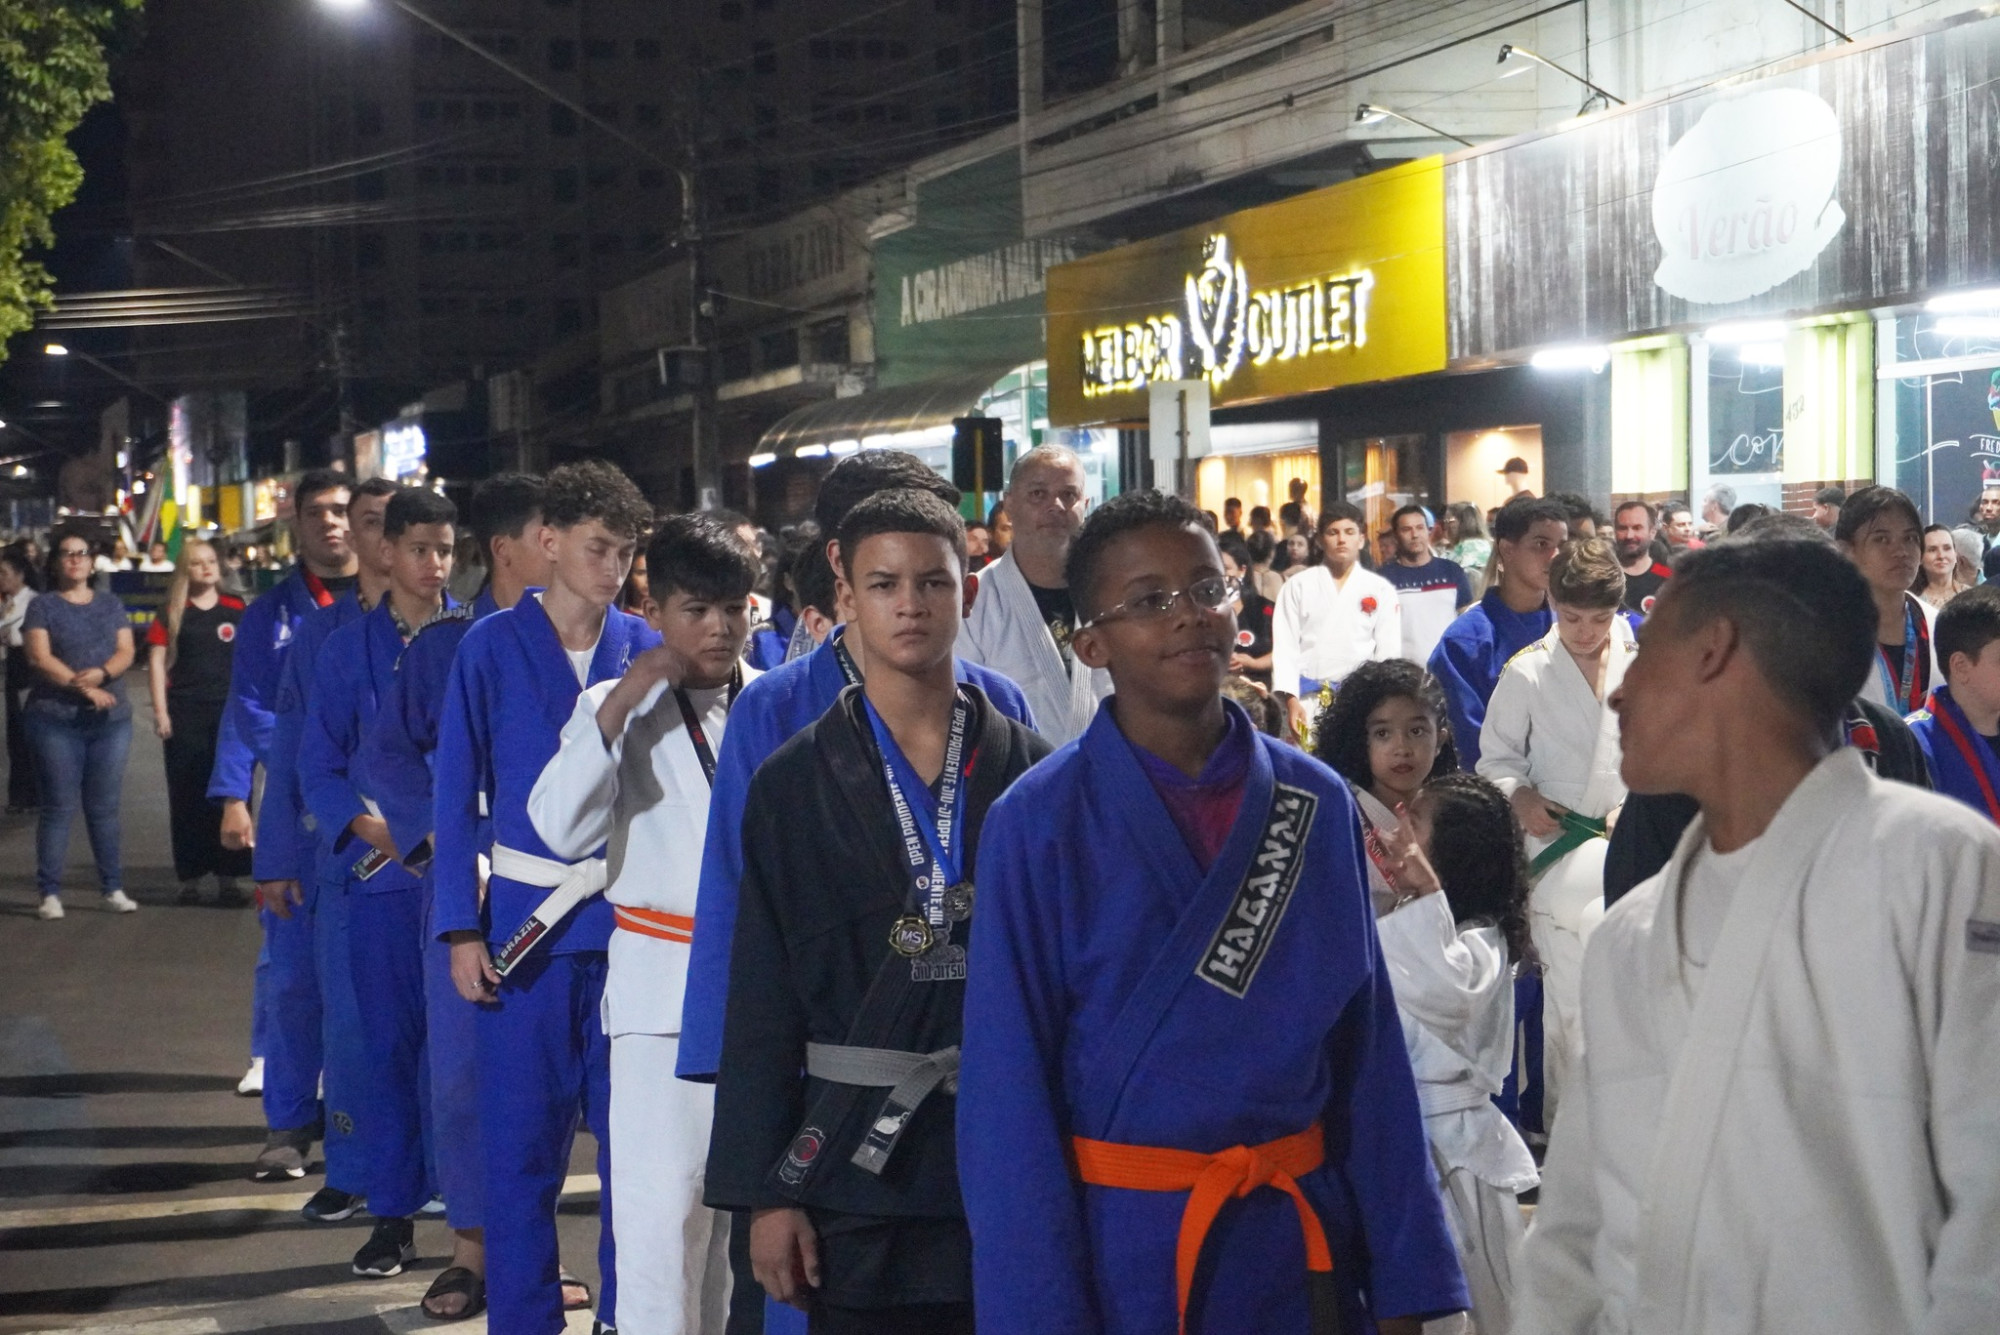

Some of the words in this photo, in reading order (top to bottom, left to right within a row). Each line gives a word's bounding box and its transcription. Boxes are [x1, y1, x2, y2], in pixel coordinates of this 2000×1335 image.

[1678, 194, 1799, 260] Verão
[1247, 270, 1373, 365] OUTLET
[952, 707, 966, 735] OPEN
[943, 733, 963, 785] PRUDENTE
[905, 835, 925, 867] OPEN
[929, 906, 944, 925] JIU
[500, 919, 539, 959] BRAZIL
[914, 964, 932, 980] JIU
[933, 963, 965, 979] JITSU
